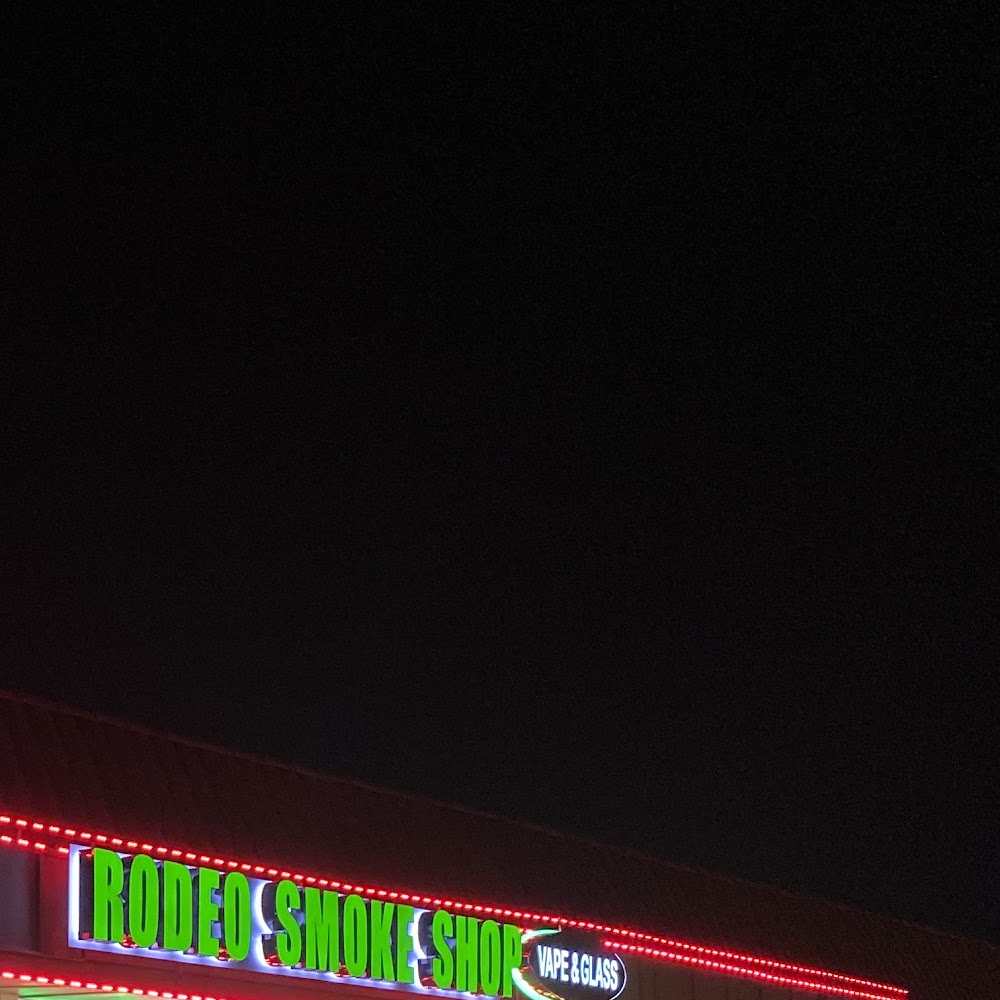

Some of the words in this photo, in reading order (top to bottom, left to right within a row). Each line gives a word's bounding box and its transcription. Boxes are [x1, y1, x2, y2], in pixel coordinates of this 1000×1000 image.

[93, 848, 251, 961] RODEO
[275, 880, 414, 984] SMOKE
[432, 910, 523, 998] SHOP
[537, 944, 570, 982] VAPE
[570, 951, 580, 985] &
[580, 953, 620, 991] GLASS
